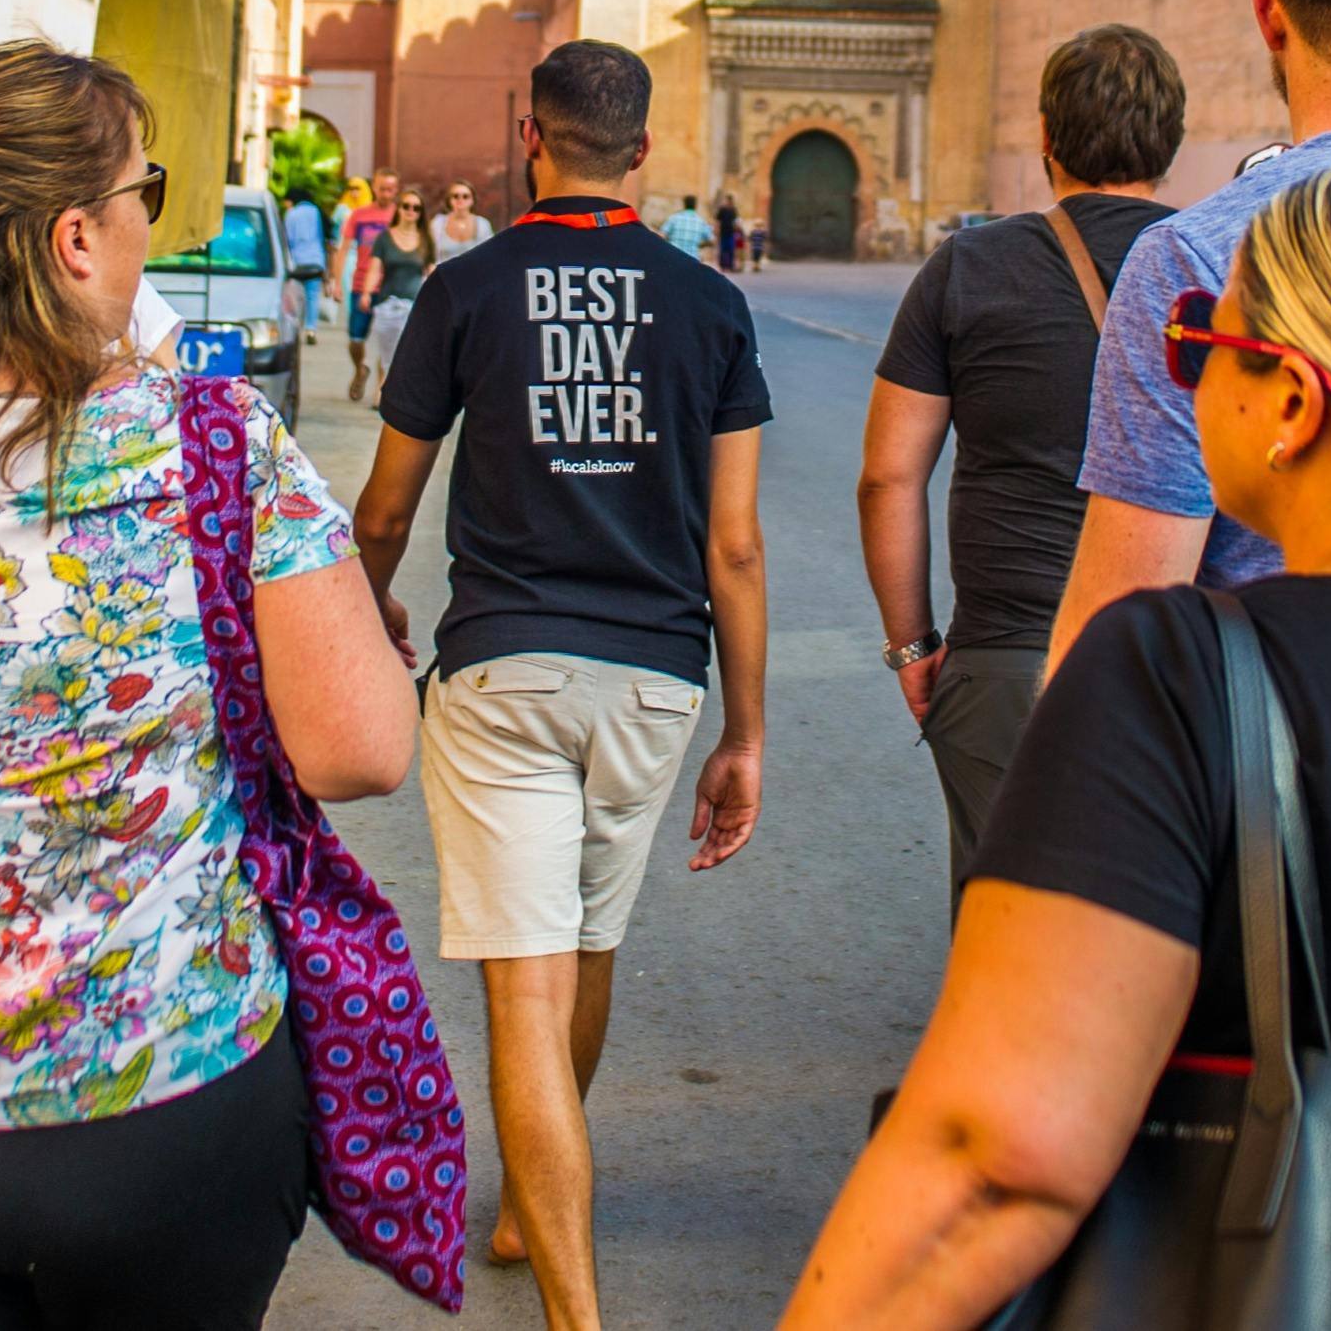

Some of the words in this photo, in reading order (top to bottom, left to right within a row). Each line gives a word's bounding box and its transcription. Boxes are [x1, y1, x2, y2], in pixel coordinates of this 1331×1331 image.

[525, 266, 654, 324] BEST.
[541, 324, 642, 382] DAY.
[528, 385, 658, 443] EVER.
[550, 458, 636, 474] #localsknow
